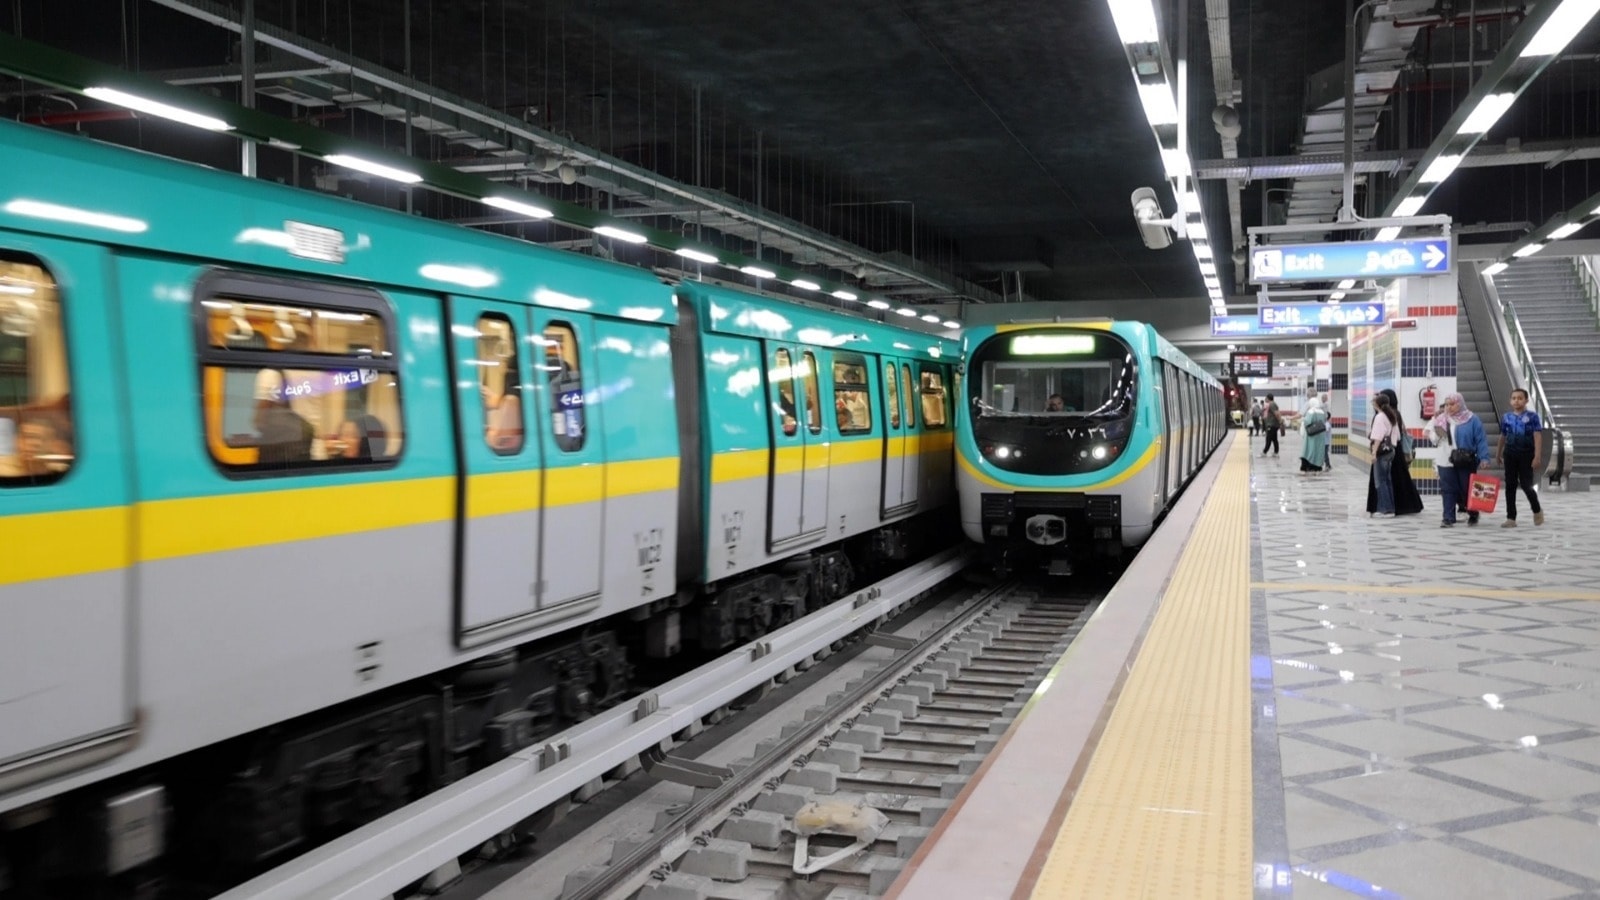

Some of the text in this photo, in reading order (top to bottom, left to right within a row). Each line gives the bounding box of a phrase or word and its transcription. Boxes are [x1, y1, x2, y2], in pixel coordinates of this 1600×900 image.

[1285, 253, 1324, 272] Exit
[1263, 306, 1300, 324] Exit
[1066, 428, 1107, 440] ٧٠٣٦
